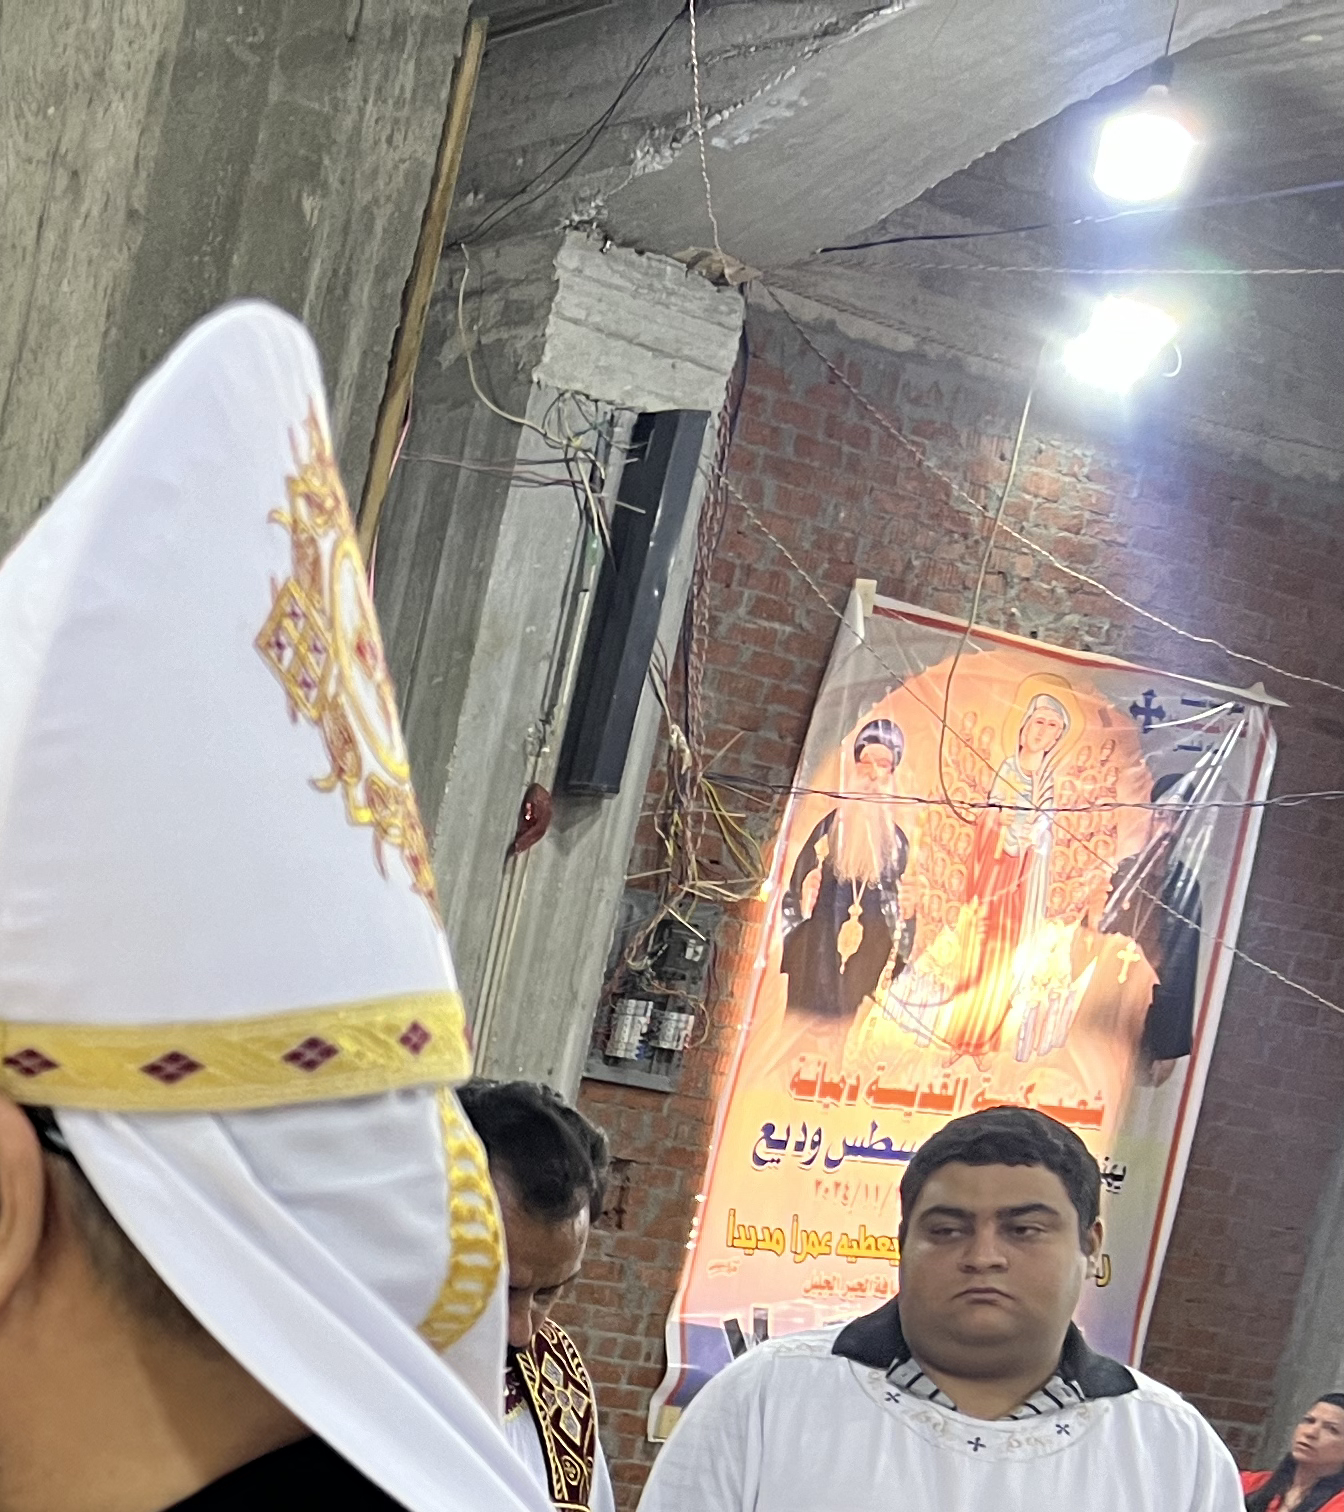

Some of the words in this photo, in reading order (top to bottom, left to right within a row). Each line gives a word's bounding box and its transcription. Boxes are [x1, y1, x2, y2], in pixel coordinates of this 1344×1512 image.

[789, 1055, 861, 1109] دميانة
[752, 1121, 822, 1167] وديع
[835, 1224, 902, 1267] يعطيه
